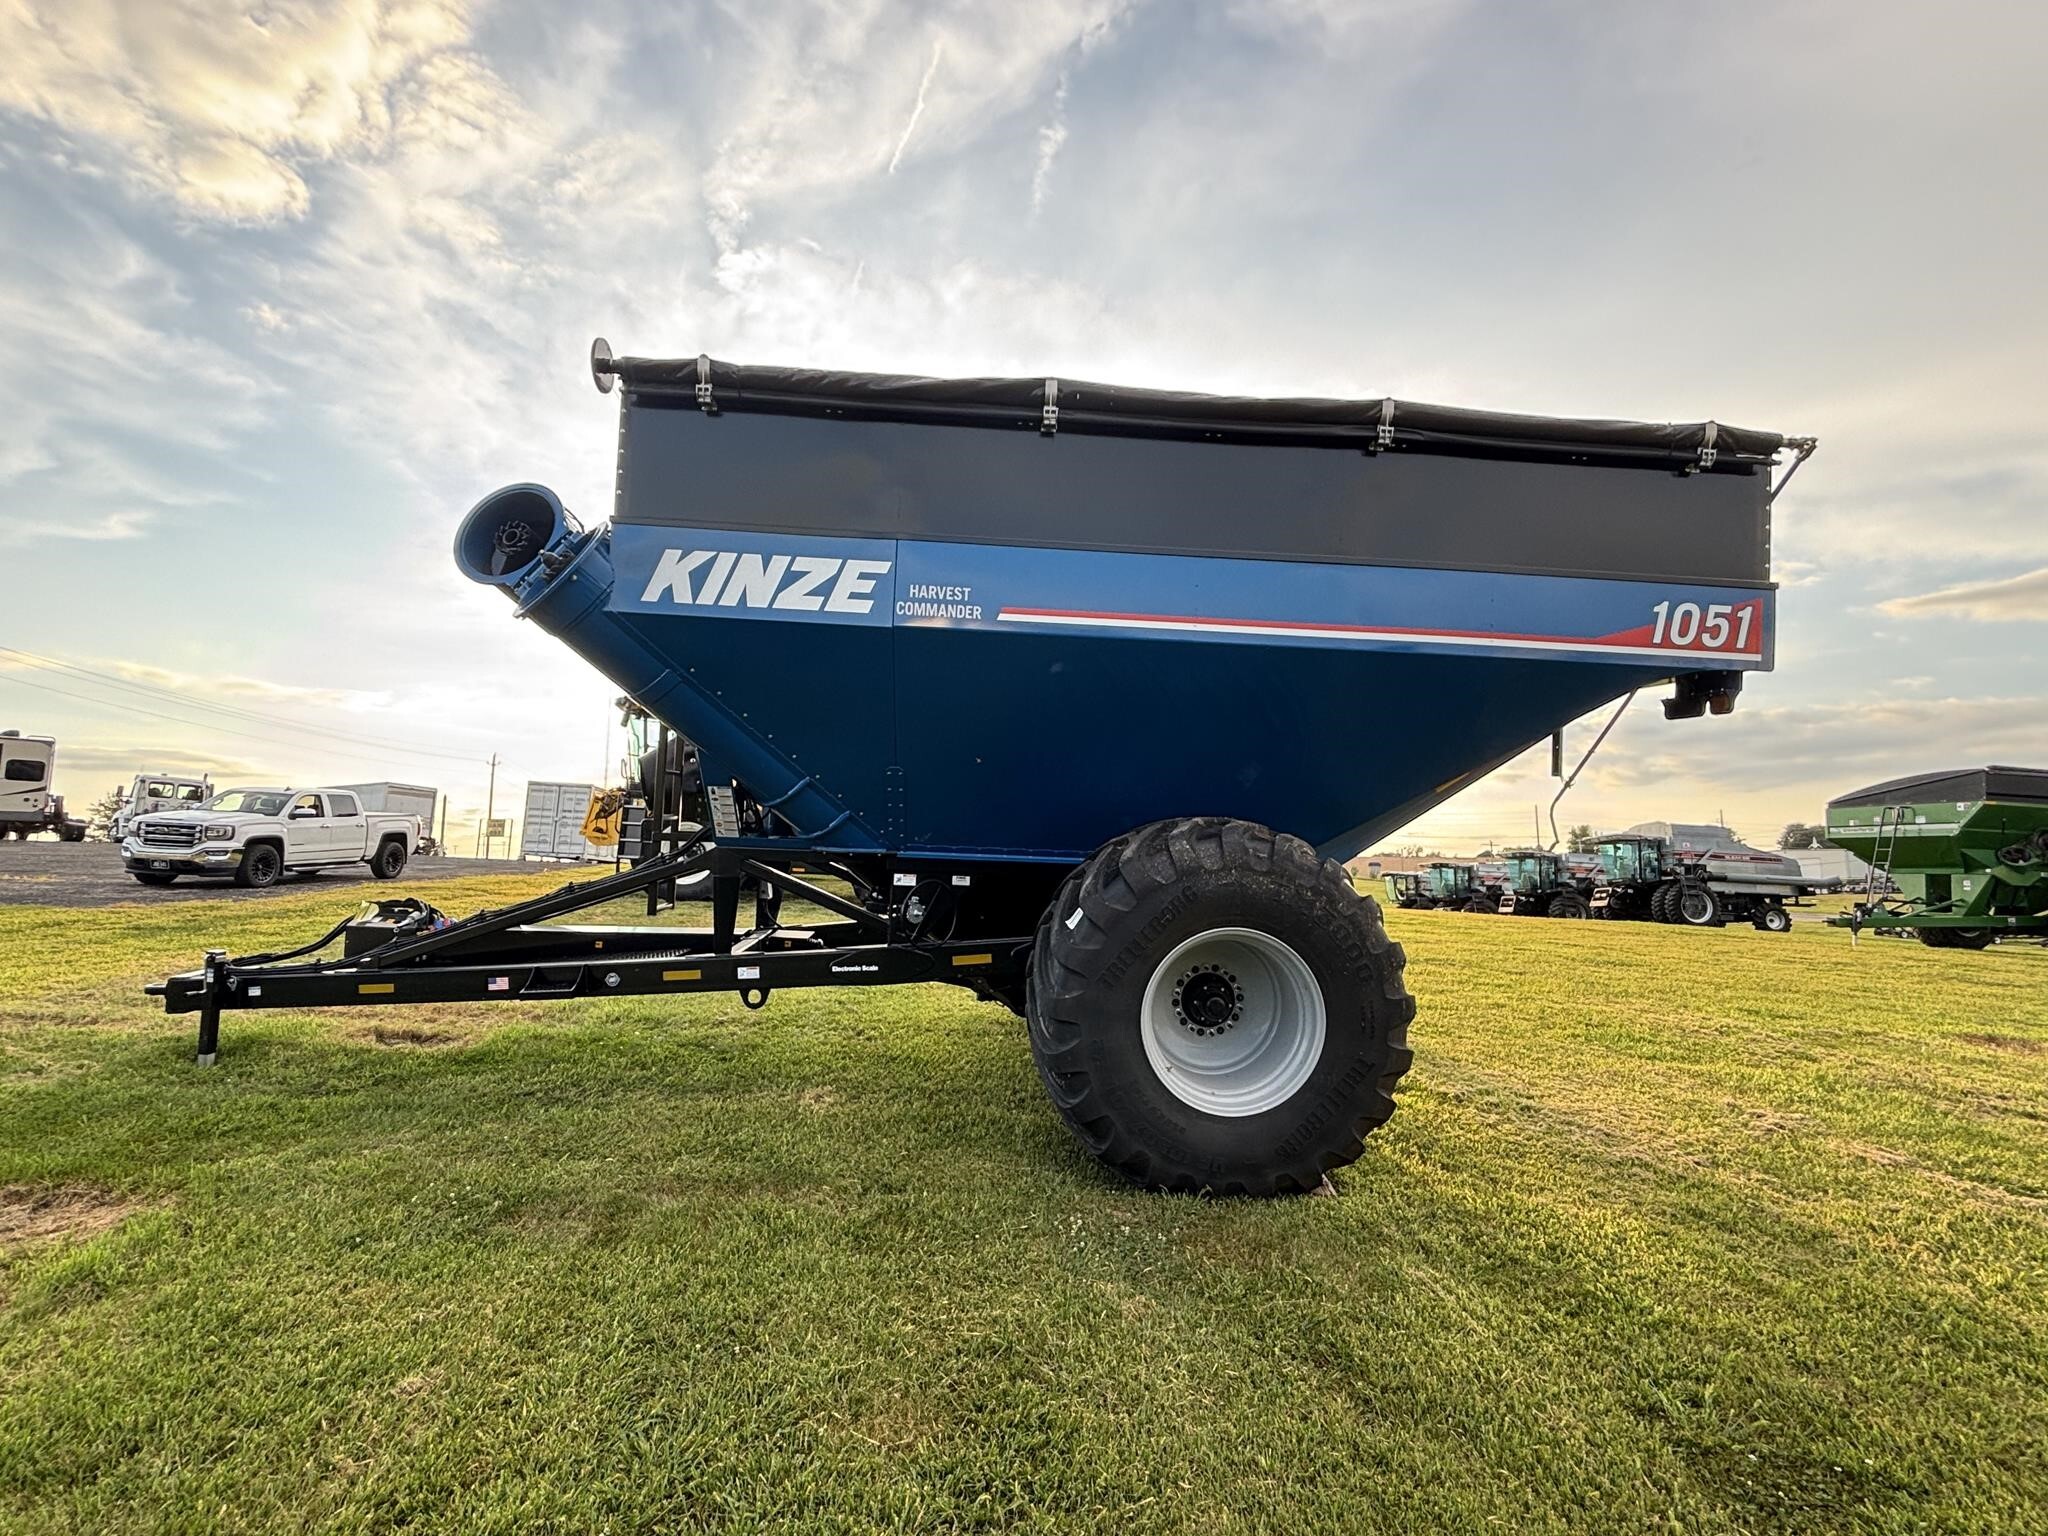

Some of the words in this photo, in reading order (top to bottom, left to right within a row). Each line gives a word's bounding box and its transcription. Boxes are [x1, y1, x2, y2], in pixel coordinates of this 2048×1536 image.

[640, 548, 892, 614] KINZE
[909, 584, 971, 601] HARVEST
[896, 601, 982, 619] COMMANDER
[1652, 600, 1752, 649] 1051
